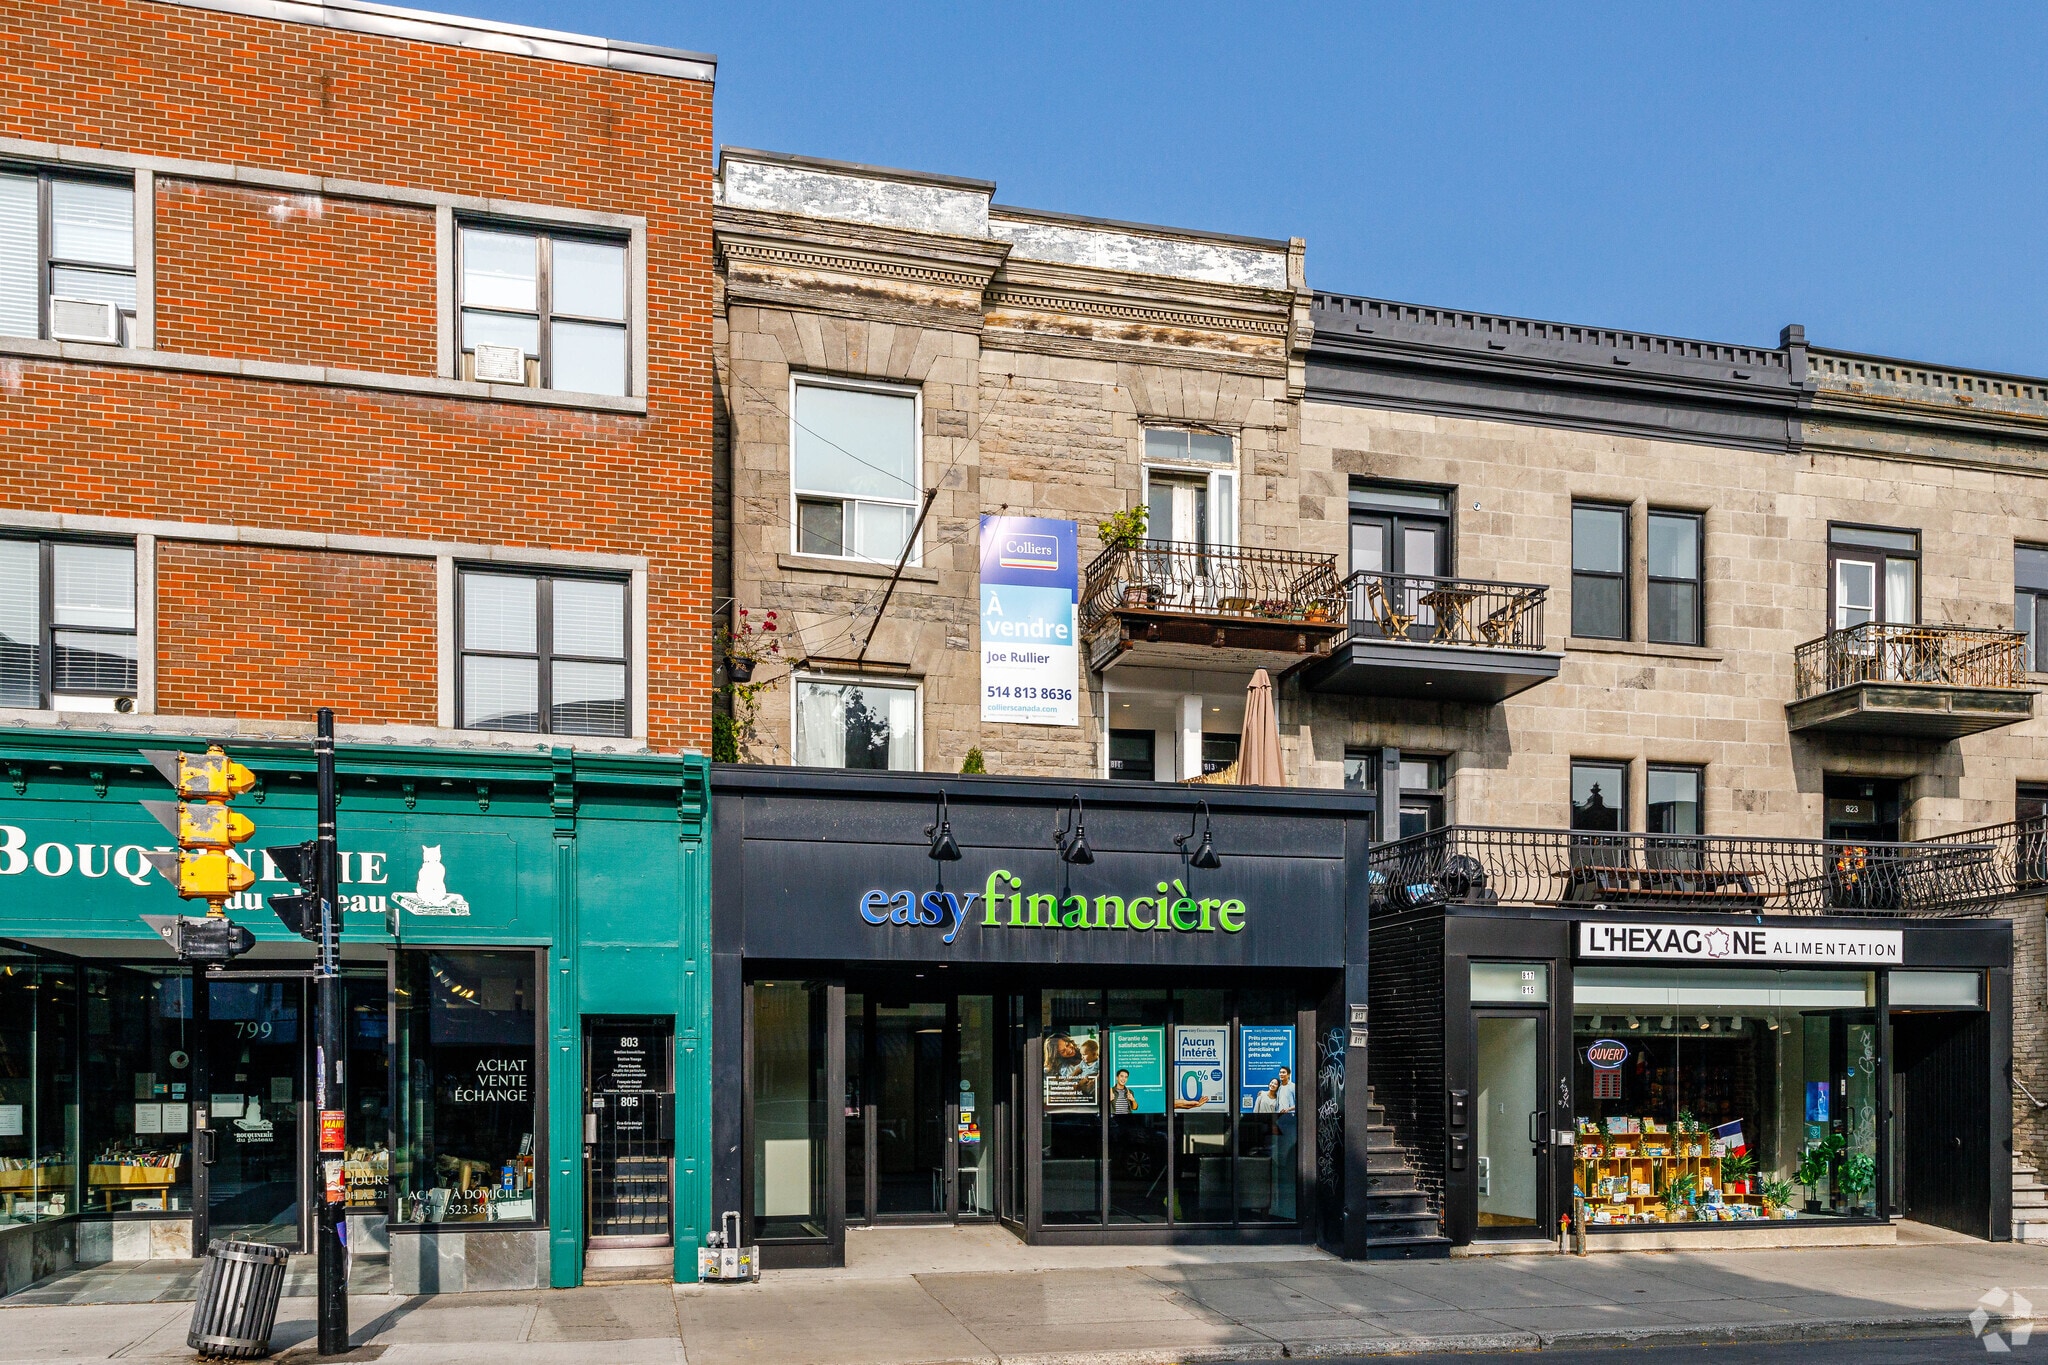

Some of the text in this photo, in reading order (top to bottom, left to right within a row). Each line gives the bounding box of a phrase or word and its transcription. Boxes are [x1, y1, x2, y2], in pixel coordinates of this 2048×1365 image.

[1006, 540, 1052, 556] Colliers
[986, 590, 1004, 616] À
[986, 617, 1069, 640] vendre
[986, 651, 1050, 664] Joe Rullier
[987, 686, 1072, 701] 514 813 8636
[987, 703, 1058, 713] collierscanada.com
[1845, 805, 1859, 813] 823
[1773, 941, 1896, 957] ALIMENTATION
[1522, 971, 1534, 980] 817
[1522, 986, 1534, 994] 815
[234, 1021, 273, 1039] 799
[620, 1037, 639, 1047] 803
[1182, 1036, 1215, 1046] Aucun
[1182, 1047, 1217, 1057] Intérêt
[1589, 1048, 1625, 1061] OUVERT
[475, 1059, 528, 1071] ACHAT
[477, 1074, 528, 1087] VENTE
[1181, 1070, 1209, 1102] 0%
[454, 1086, 528, 1102] ÉCHANGE
[620, 1096, 639, 1107] 805
[464, 1188, 525, 1201] DOMICILE
